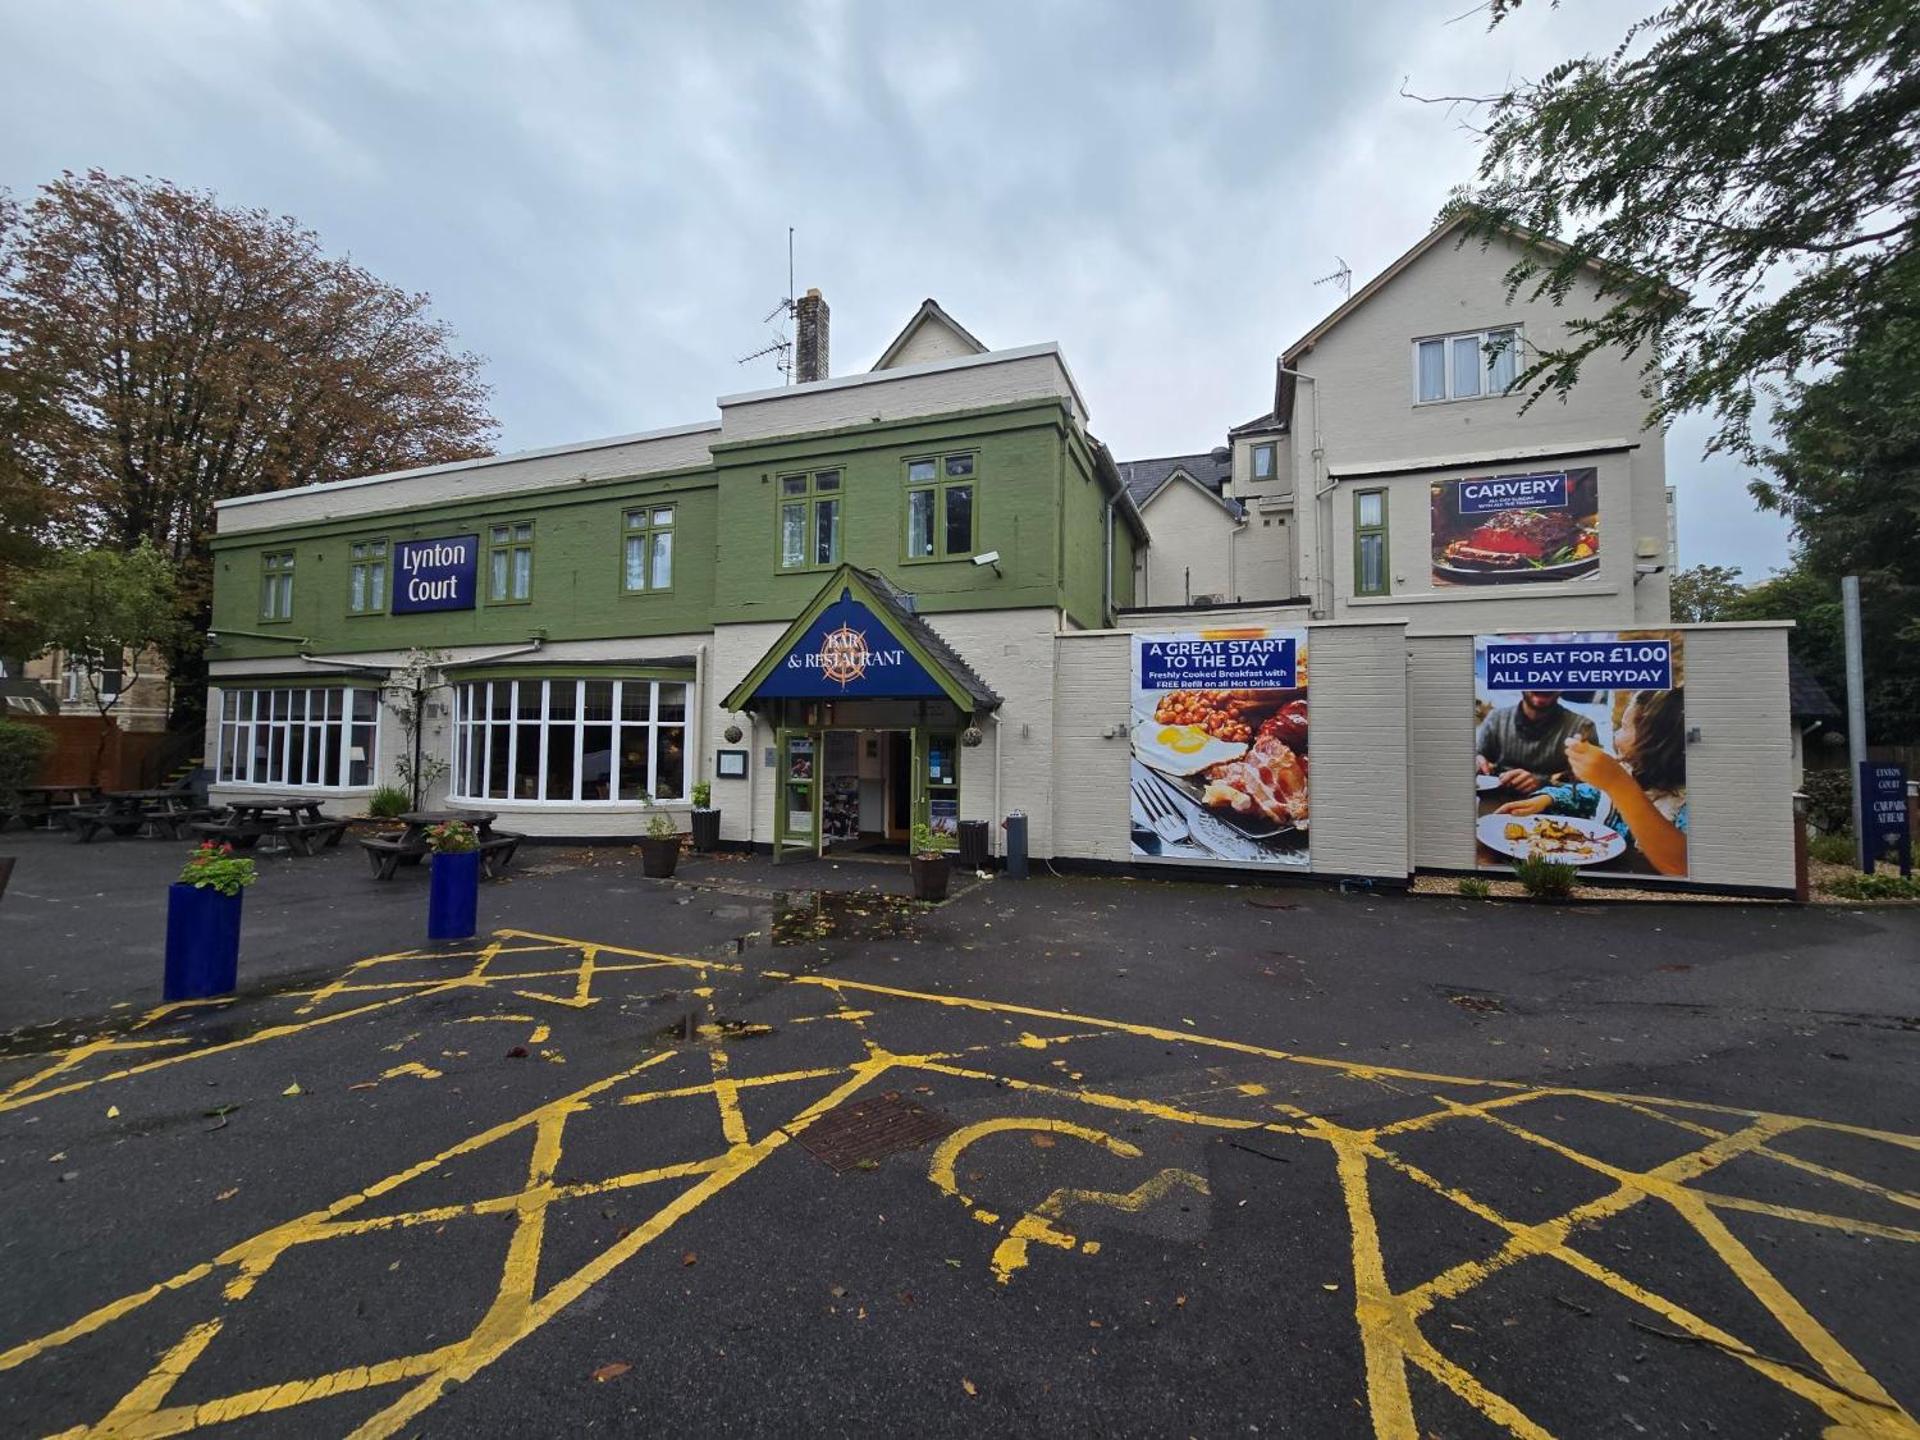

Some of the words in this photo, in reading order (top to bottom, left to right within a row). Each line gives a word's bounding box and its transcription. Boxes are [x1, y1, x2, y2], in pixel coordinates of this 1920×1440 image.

[1465, 479, 1559, 498] CARVERY
[403, 543, 465, 575] Lynton
[408, 575, 457, 602] Court
[828, 633, 860, 648] BAR
[1150, 643, 1162, 656] A
[1166, 641, 1224, 655] GREAT
[1228, 639, 1286, 654] START
[788, 654, 802, 668] &
[805, 649, 904, 668] RESTAURANT
[1163, 656, 1188, 668] TO
[1191, 655, 1226, 668] THE
[1231, 653, 1269, 667] DAY
[1490, 652, 1529, 664] KIDS
[1533, 651, 1566, 664] EAT
[1569, 651, 1605, 663] FOR
[1609, 647, 1668, 663] £1.00
[1149, 671, 1180, 679] Freshly
[1182, 670, 1217, 678] Cooked
[1219, 670, 1263, 678] Breakfast
[1265, 669, 1287, 677] with
[1492, 671, 1524, 683] ALL
[1527, 670, 1563, 683] DAY
[1567, 669, 1663, 683] EVERYDAY
[1156, 680, 1180, 688] FREE
[1181, 680, 1202, 688] Refill
[1250, 679, 1281, 687] Drinks
